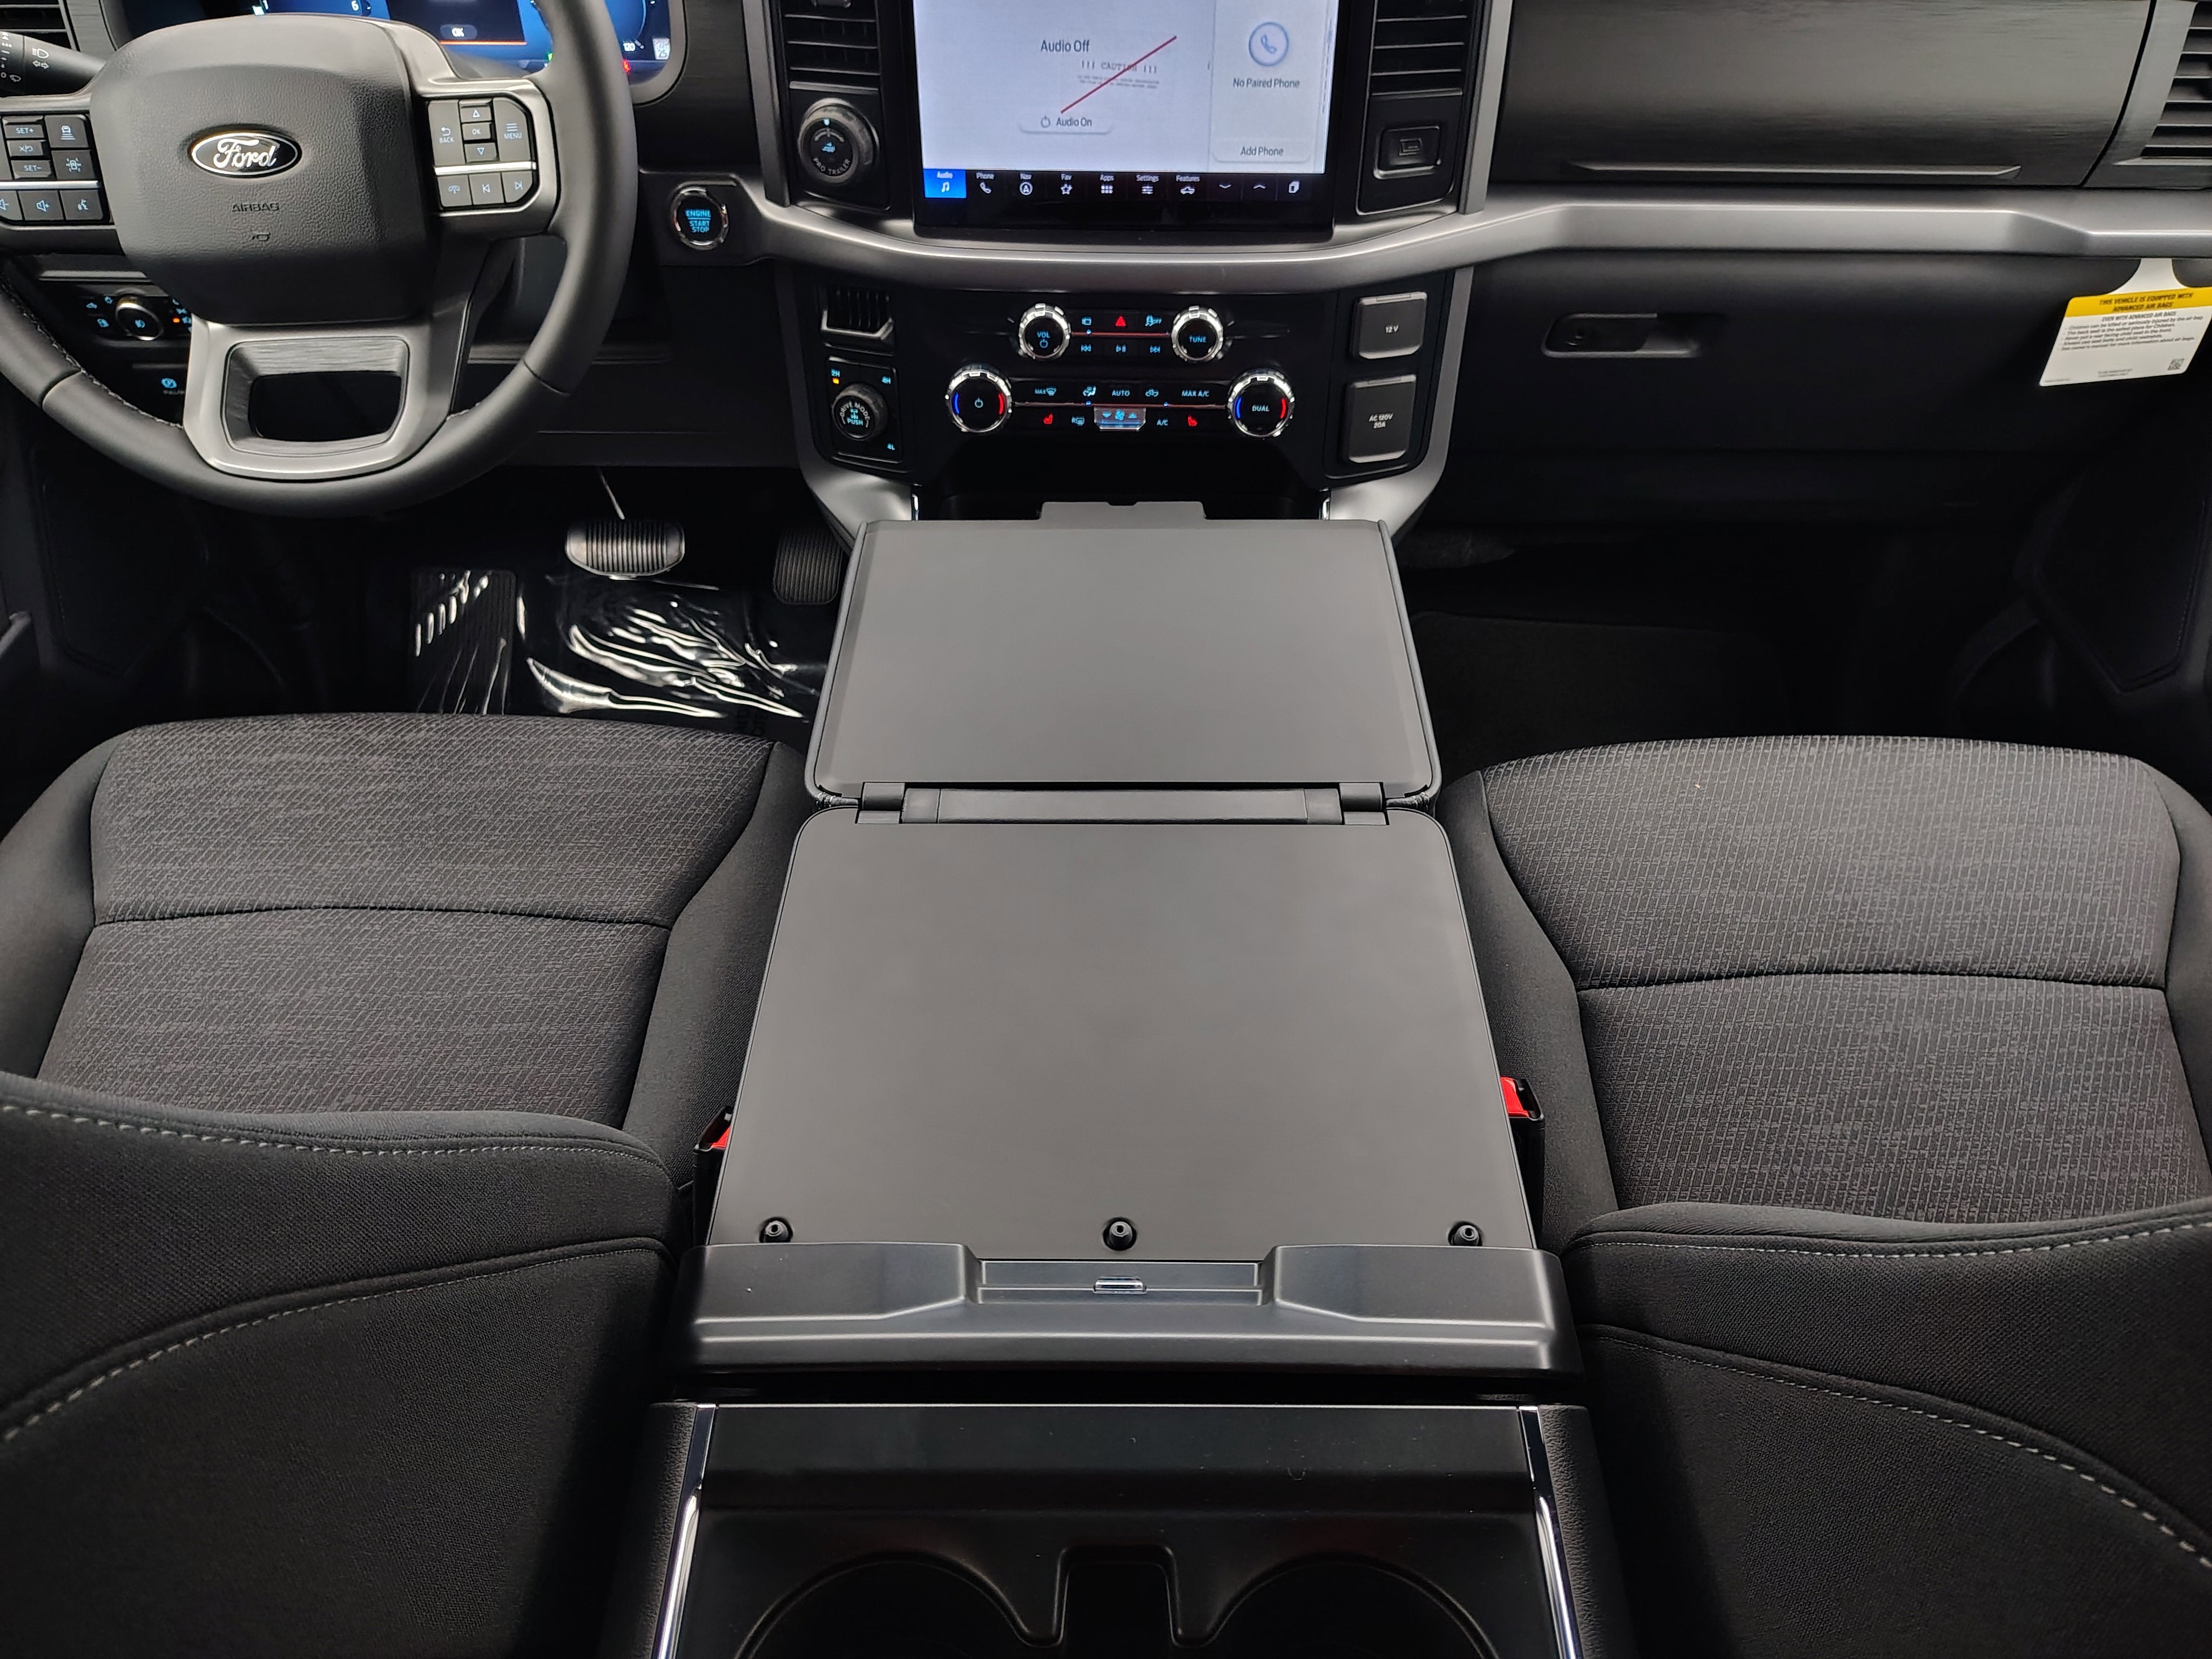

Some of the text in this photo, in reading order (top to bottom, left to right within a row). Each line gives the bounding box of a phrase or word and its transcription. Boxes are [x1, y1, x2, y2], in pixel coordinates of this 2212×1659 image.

[452, 28, 464, 37] OK
[1041, 39, 1090, 52] Audio Off
[1233, 78, 1300, 88] No Paired Phone
[1056, 117, 1092, 126] Audio On
[213, 138, 277, 168] Ford
[1240, 146, 1284, 156] Add Phone
[812, 157, 826, 172] PRO
[1136, 174, 1159, 183] Settings
[232, 202, 280, 212] AIRBAG
[685, 210, 711, 218] ENGINE
[831, 369, 840, 377] 2H
[881, 376, 891, 384] 4H
[840, 402, 870, 420] DRIVE MODE
[847, 417, 863, 426] PUSH
[1379, 413, 1394, 421] 120V
